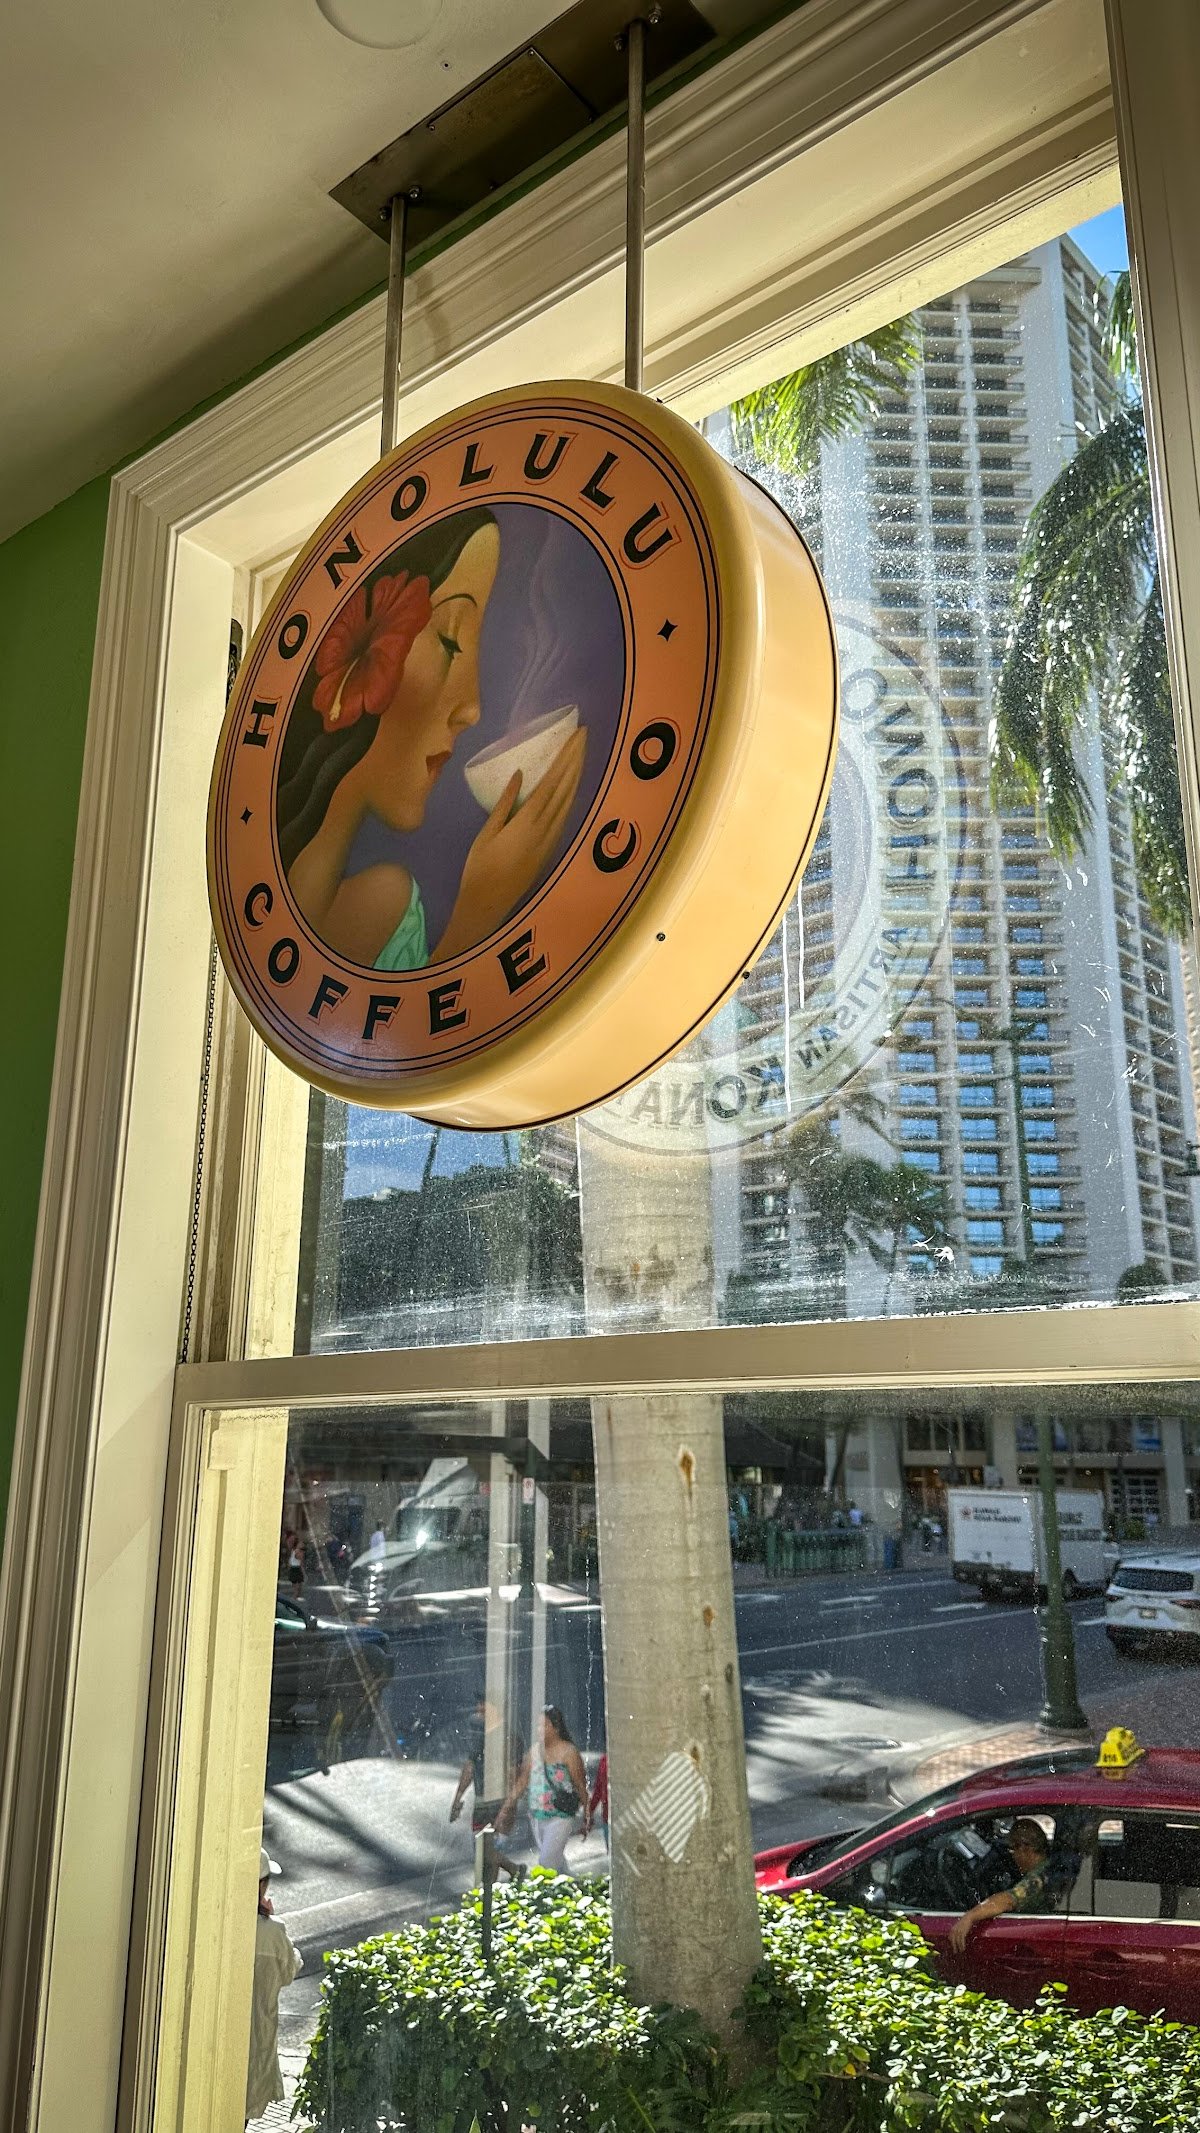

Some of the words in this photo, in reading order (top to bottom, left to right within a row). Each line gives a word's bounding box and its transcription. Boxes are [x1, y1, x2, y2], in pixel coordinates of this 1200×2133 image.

[242, 430, 682, 748] HONOLULU
[243, 880, 552, 1042] COFFEE
[591, 717, 682, 876] CO
